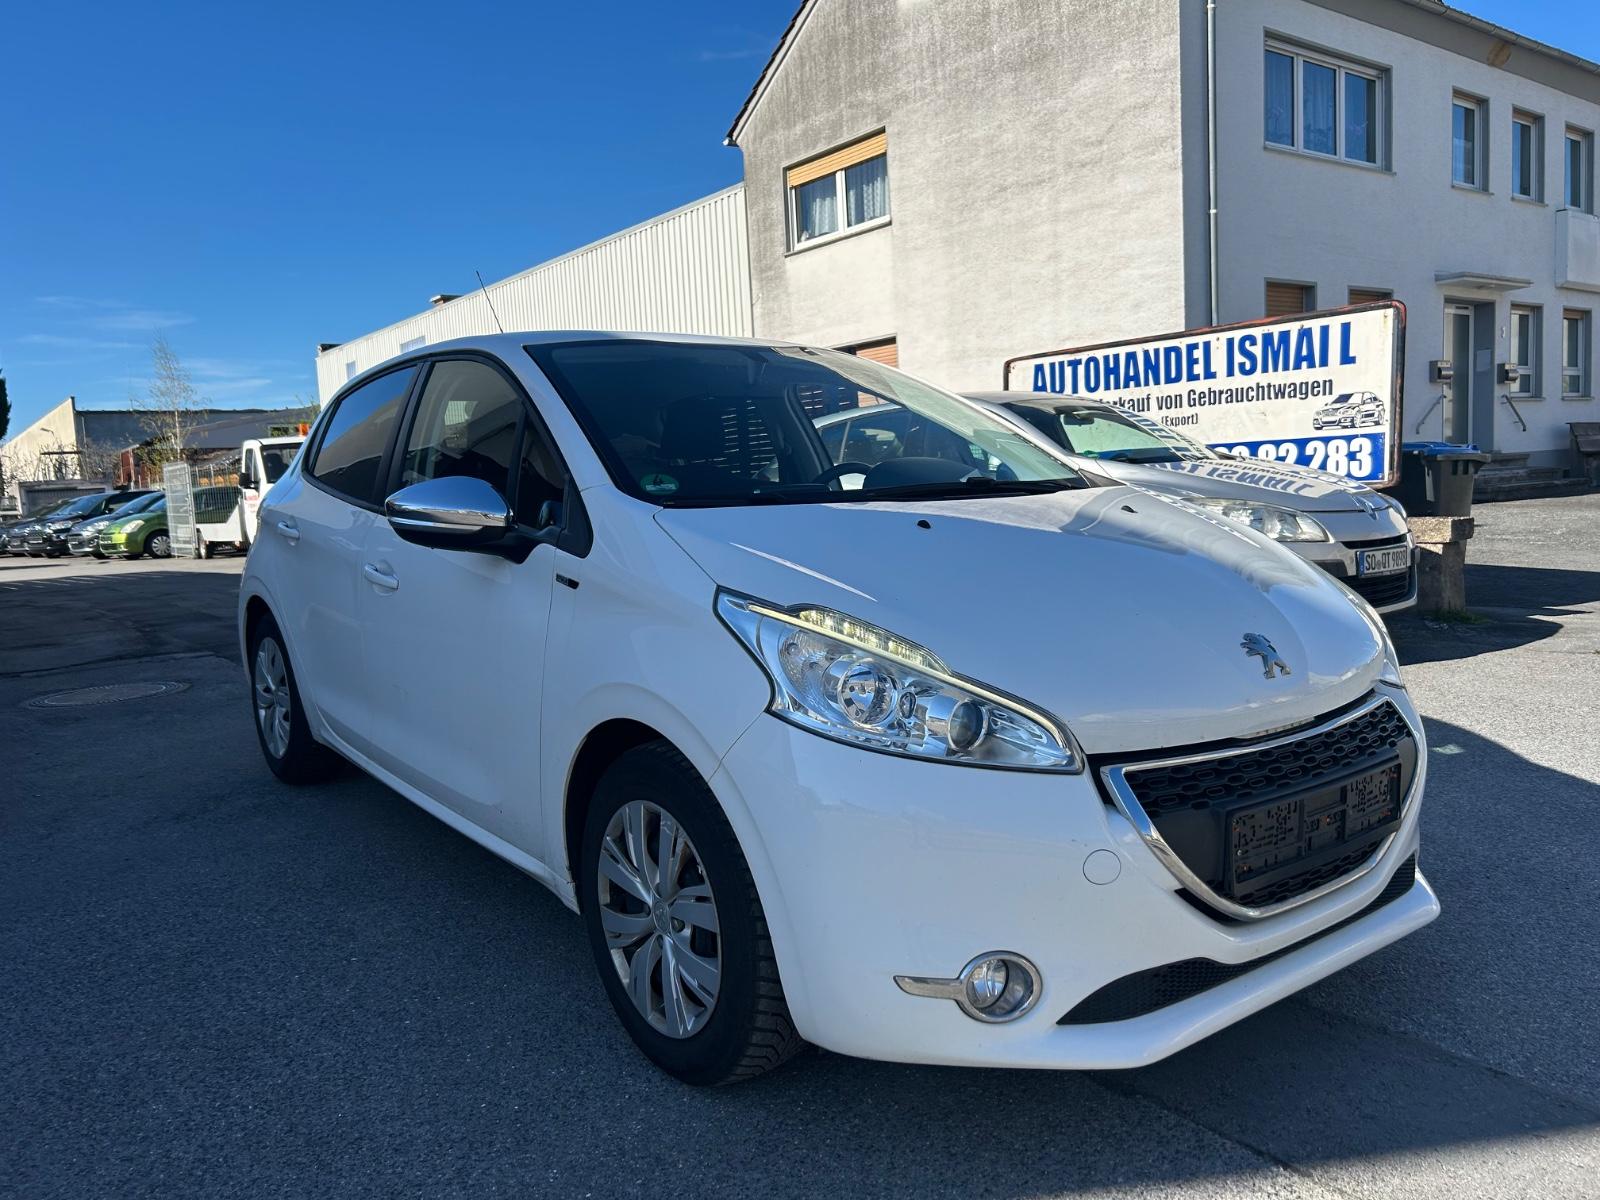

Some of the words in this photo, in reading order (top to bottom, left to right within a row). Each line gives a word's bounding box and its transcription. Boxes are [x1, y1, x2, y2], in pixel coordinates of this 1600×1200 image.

[1033, 340, 1217, 395] AUTOHANDEL
[1156, 393, 1183, 411] von
[1187, 378, 1333, 408] Gebrauchtwagen
[1161, 413, 1199, 428] (Export)
[1305, 437, 1373, 479] 283
